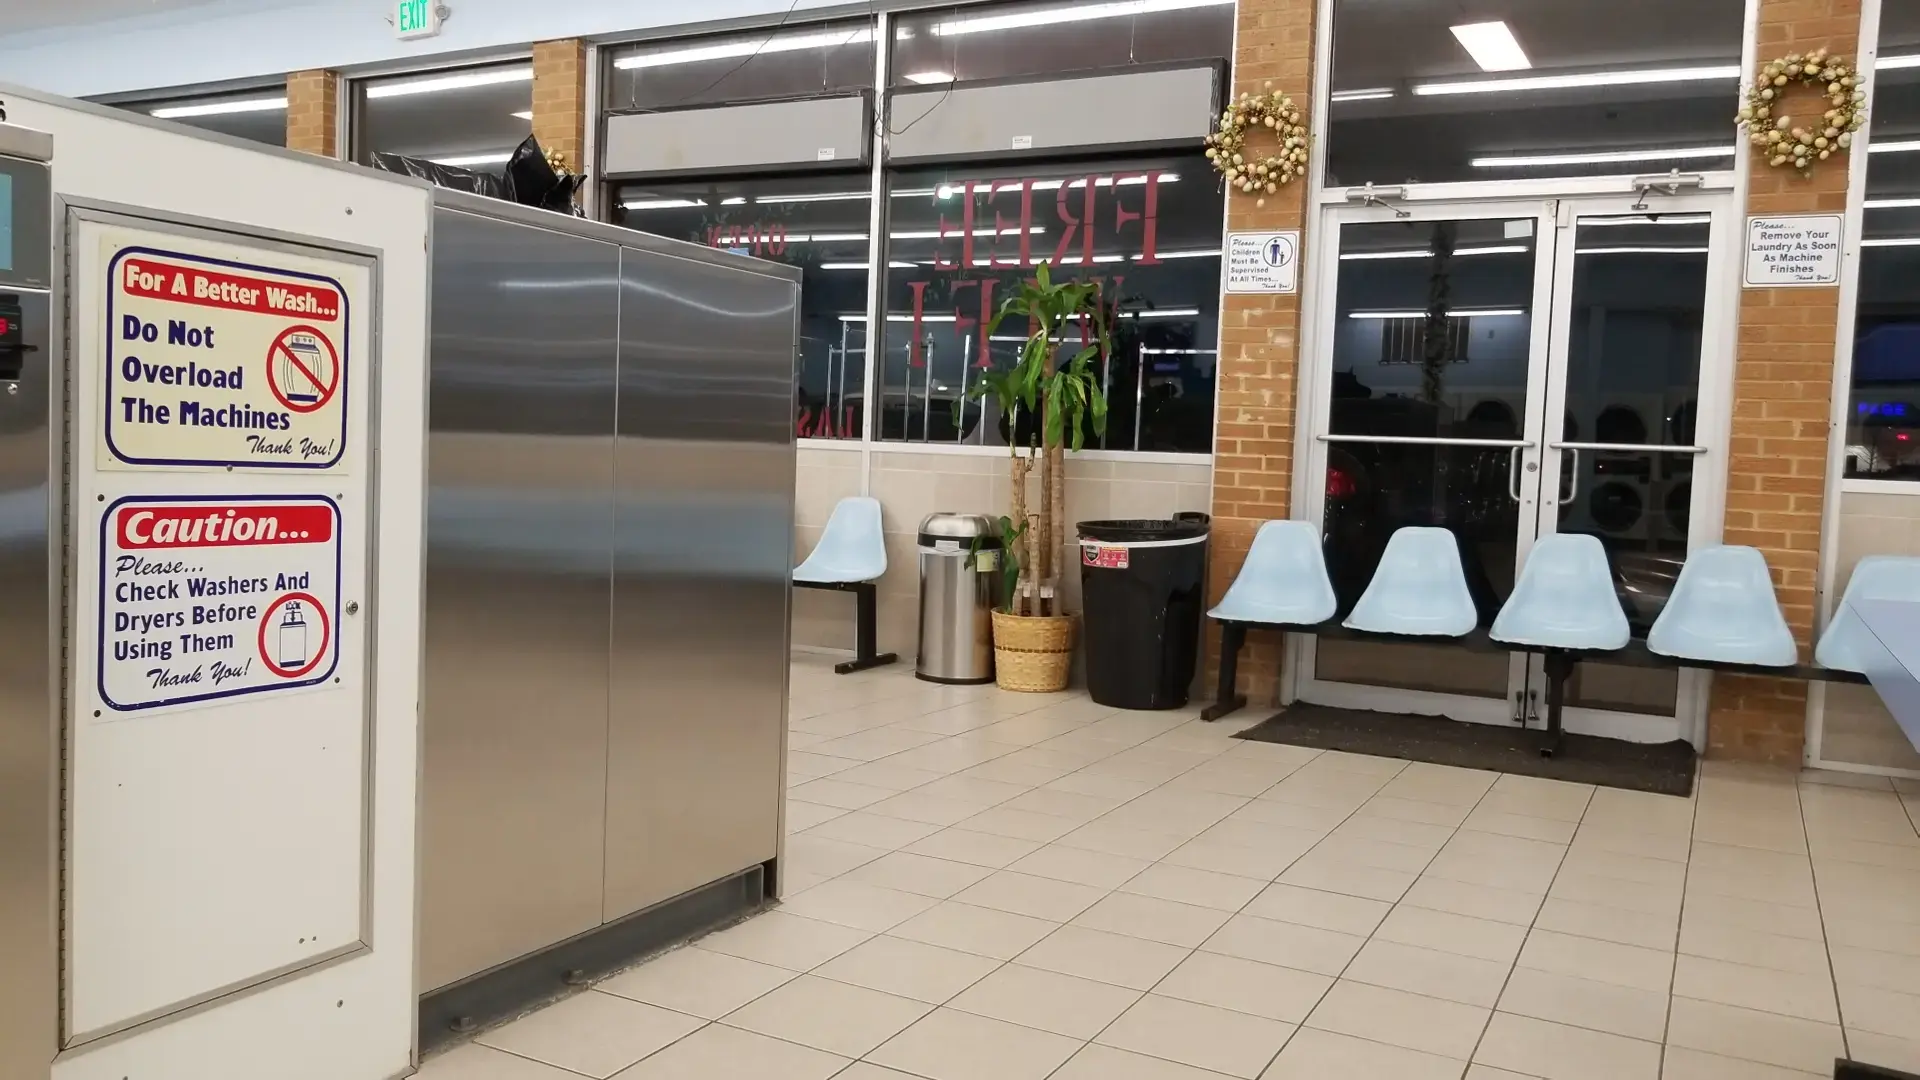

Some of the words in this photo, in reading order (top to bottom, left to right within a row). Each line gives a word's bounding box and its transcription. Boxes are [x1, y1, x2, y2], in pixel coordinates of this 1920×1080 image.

[400, 0, 428, 31] EXIT
[1752, 243, 1792, 252] Laundry
[1795, 242, 1807, 250] As
[1780, 254, 1822, 262] Machine
[1770, 265, 1813, 273] Finishes
[126, 264, 165, 291] For
[171, 273, 187, 295] A
[194, 276, 260, 306] Better
[266, 286, 336, 316] Wash...
[123, 315, 158, 343] Do
[168, 320, 214, 348] Not
[122, 356, 243, 390] Overload
[121, 397, 170, 424] The
[180, 401, 290, 430] Machines
[246, 435, 293, 455] Thank
[300, 437, 335, 460] You!
[125, 509, 309, 544] Caution...
[115, 554, 204, 577] Please...
[116, 580, 179, 603] Check
[187, 575, 268, 597] Washers
[274, 571, 309, 591] And
[114, 610, 185, 635] Dryers
[192, 604, 257, 625] Before
[114, 638, 172, 661] Using
[180, 631, 234, 653] Them
[146, 668, 202, 689] Thank
[211, 657, 251, 680] You!
